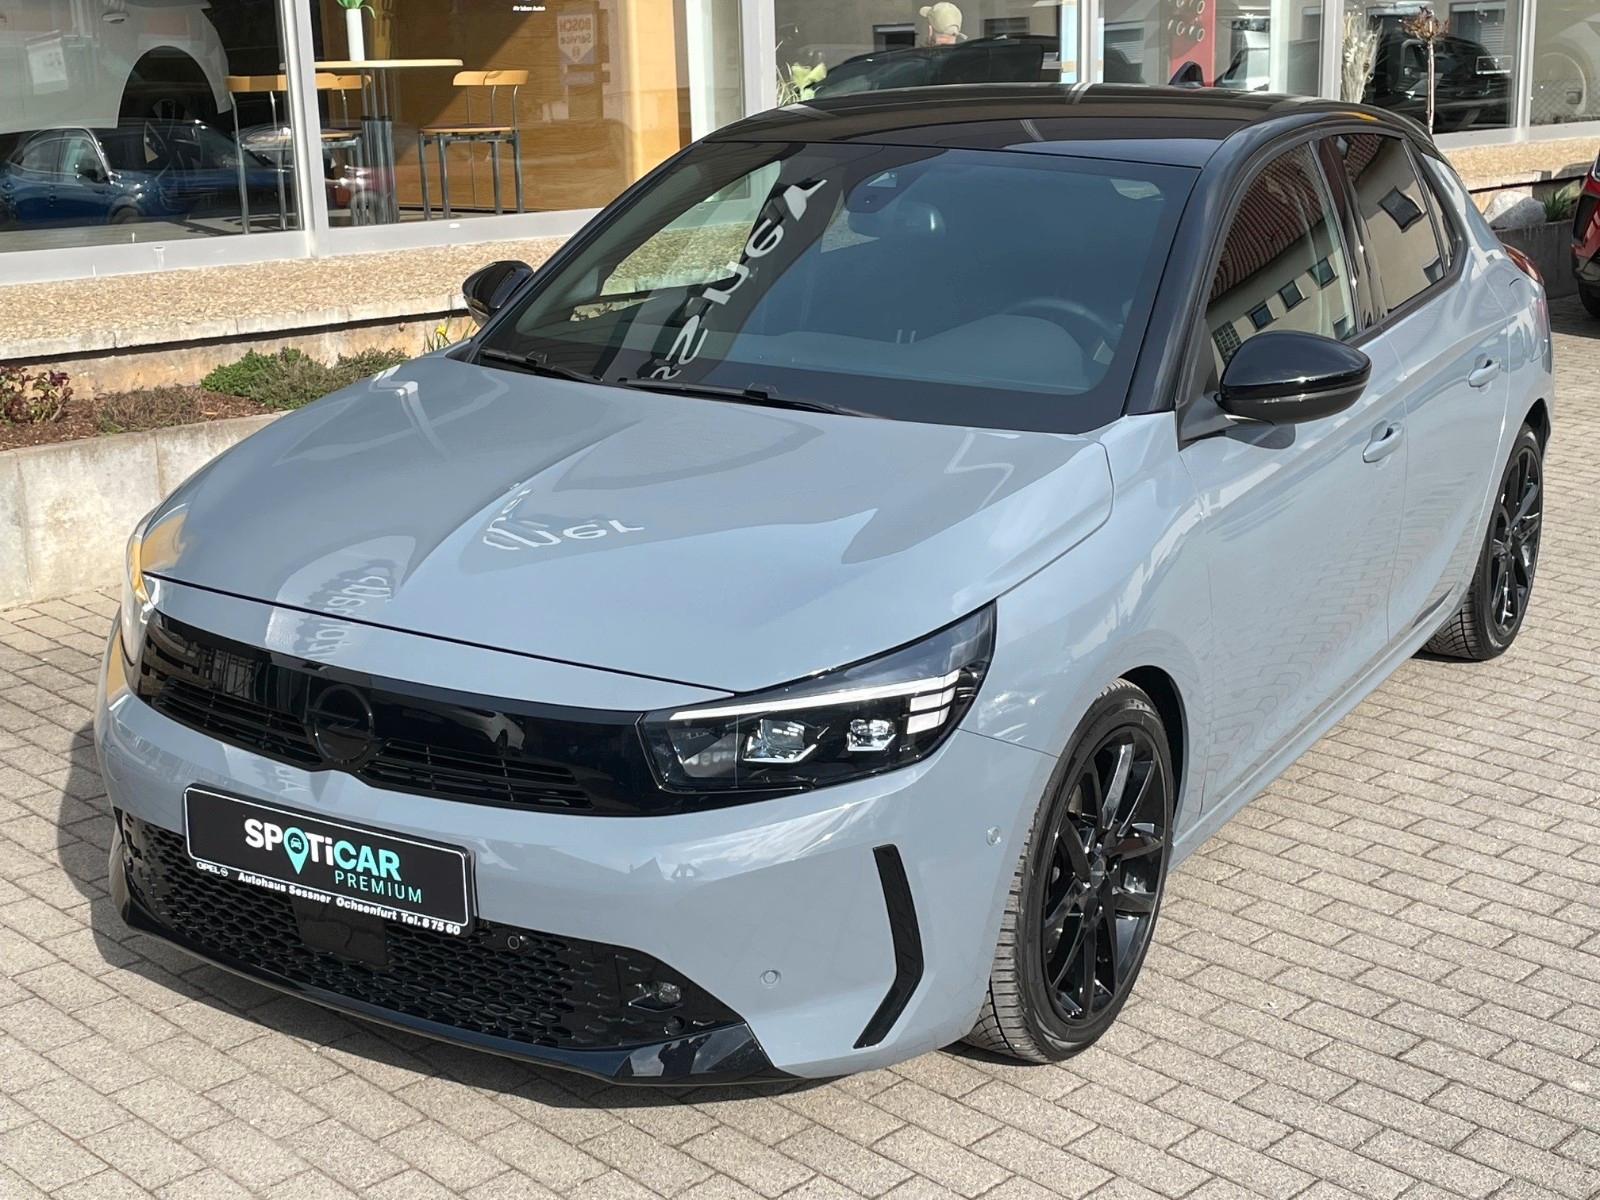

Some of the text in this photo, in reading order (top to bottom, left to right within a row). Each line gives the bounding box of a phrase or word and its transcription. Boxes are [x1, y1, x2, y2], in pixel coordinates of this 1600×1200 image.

[196, 861, 221, 875] OPEL
[238, 872, 287, 892] Autohaus
[288, 885, 332, 904] Sessner
[335, 897, 397, 920] Ochsenfurt
[335, 870, 422, 904] PREMIUM
